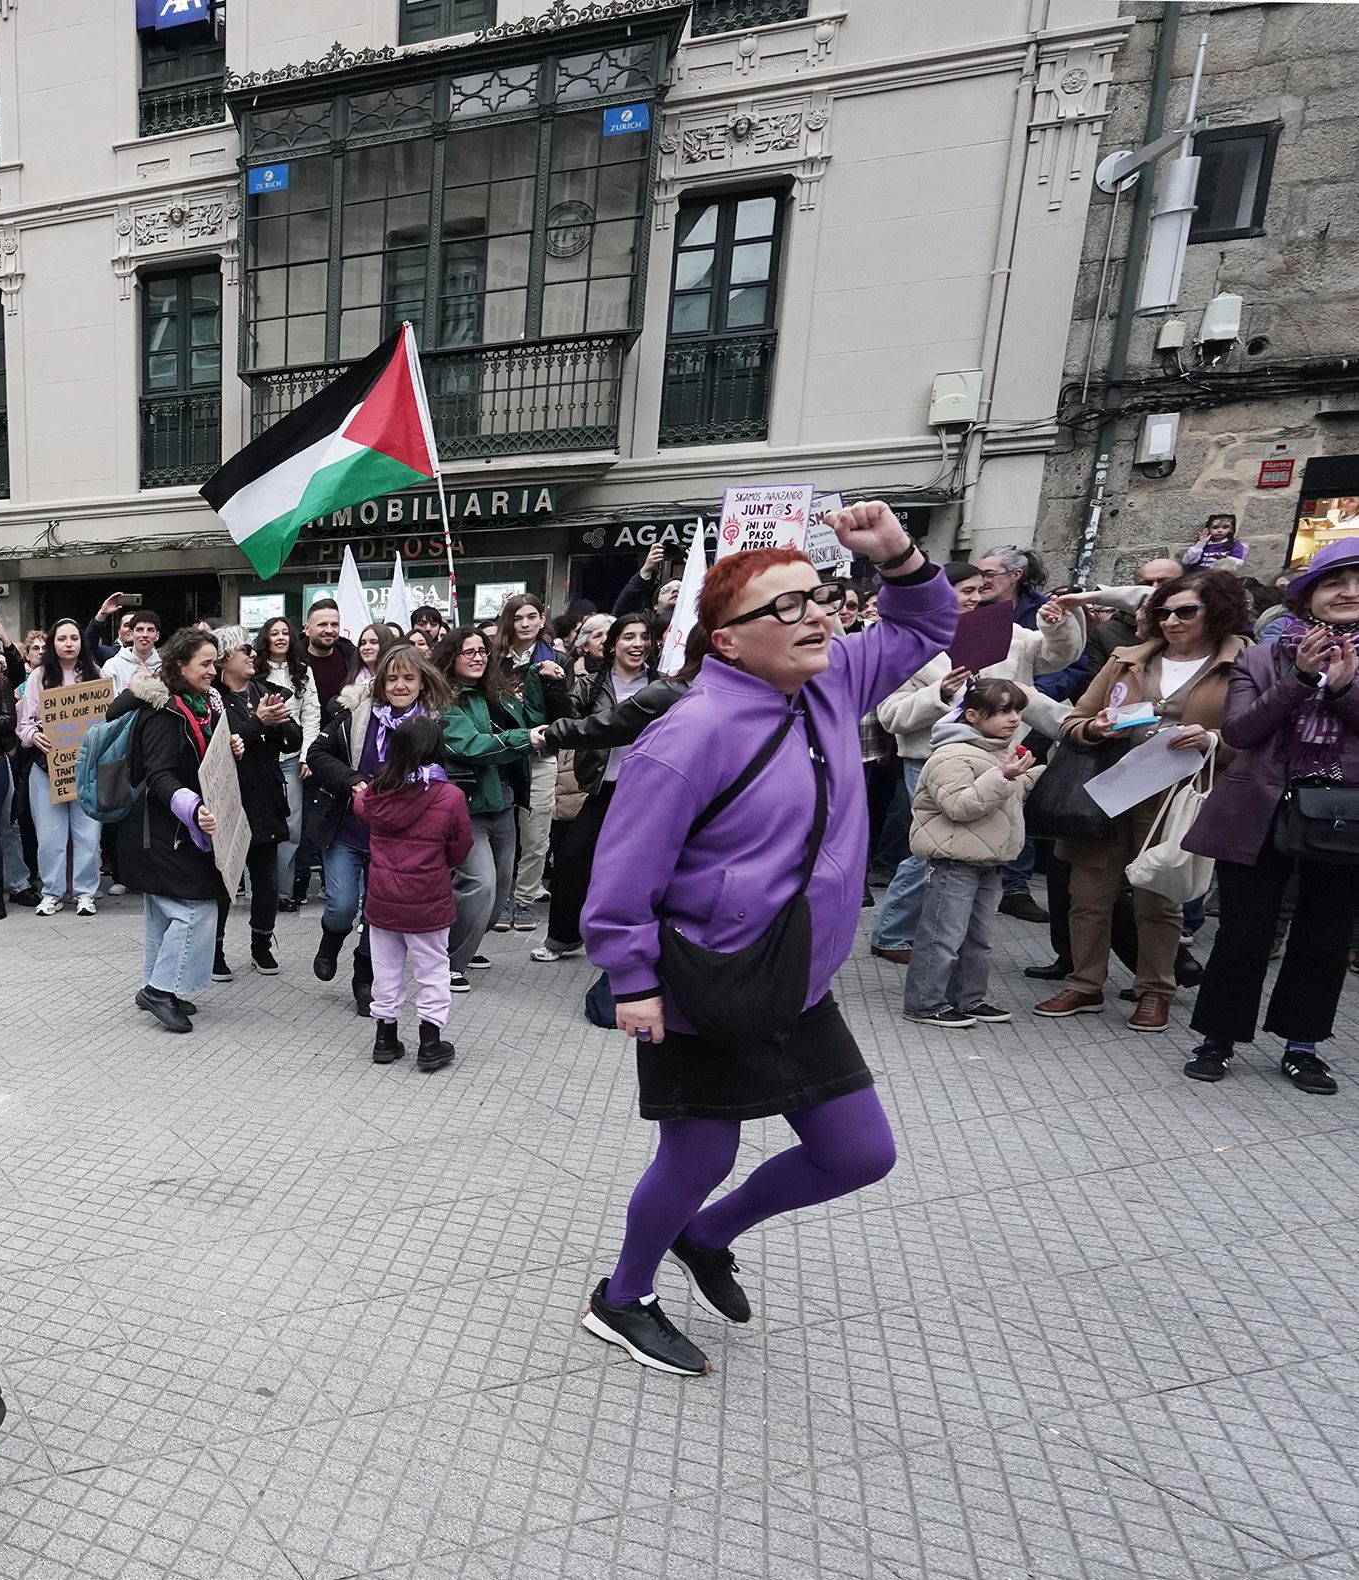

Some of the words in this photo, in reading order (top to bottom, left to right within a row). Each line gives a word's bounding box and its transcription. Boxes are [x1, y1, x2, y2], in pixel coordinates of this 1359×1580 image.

[610, 121, 642, 132] ZURICH
[735, 492, 762, 502] SIGAMOS
[741, 503, 793, 518] JUNT@S
[763, 520, 776, 530] UN
[748, 530, 774, 540] PASO
[808, 545, 842, 564] ANCIA
[110, 555, 118, 568] 6
[44, 698, 56, 709] EN
[61, 696, 76, 706] UN
[79, 688, 110, 702] MUNDO
[45, 713, 56, 723] EN
[60, 710, 68, 720] EL
[72, 706, 90, 718] QUE
[55, 764, 76, 777] TANT
[58, 787, 69, 796] EL
